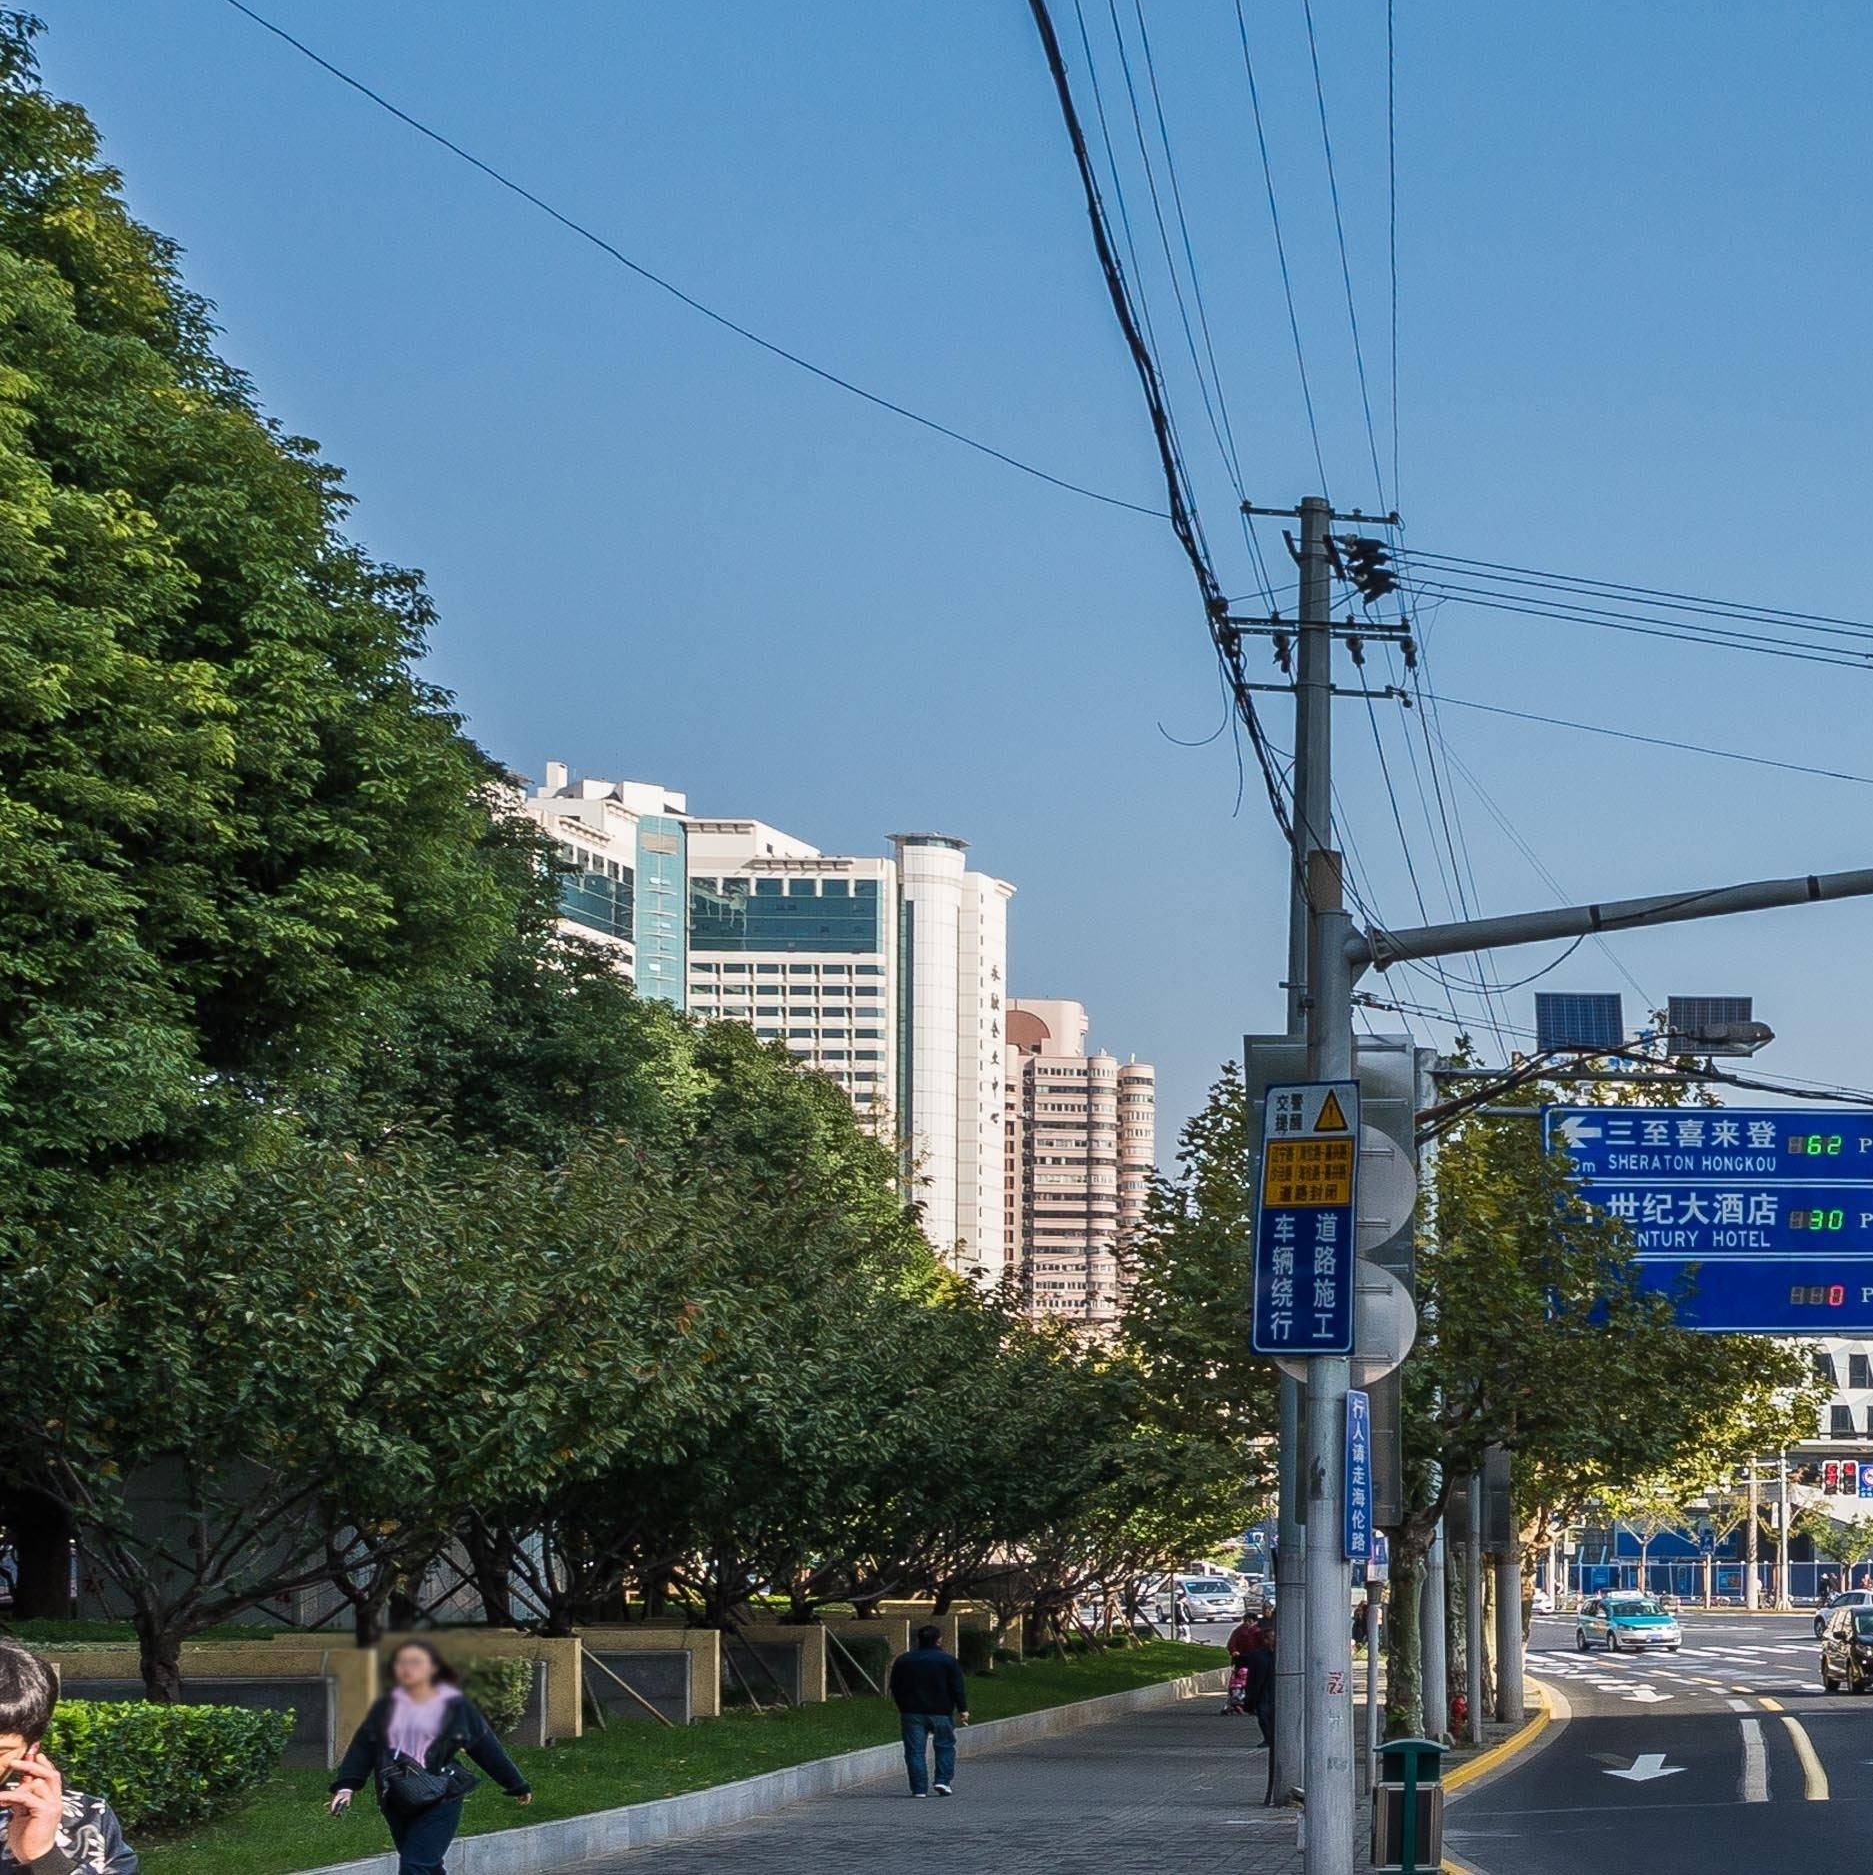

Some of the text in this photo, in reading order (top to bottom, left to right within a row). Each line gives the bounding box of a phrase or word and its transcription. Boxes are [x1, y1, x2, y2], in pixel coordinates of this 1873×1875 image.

[1605, 1119, 1873, 1155] 三至喜来登 62 P
[1608, 1154, 1694, 1172] SHERATON
[1701, 1155, 1777, 1173] HONGKOU
[1605, 1192, 1873, 1230] 世纪大酒店 30 P
[1712, 1230, 1771, 1248] HOTEL
[1269, 1212, 1297, 1341] 车辆绕行
[1312, 1212, 1339, 1339] 道路施工
[1351, 1397, 1367, 1553] 行人请走海伦路
